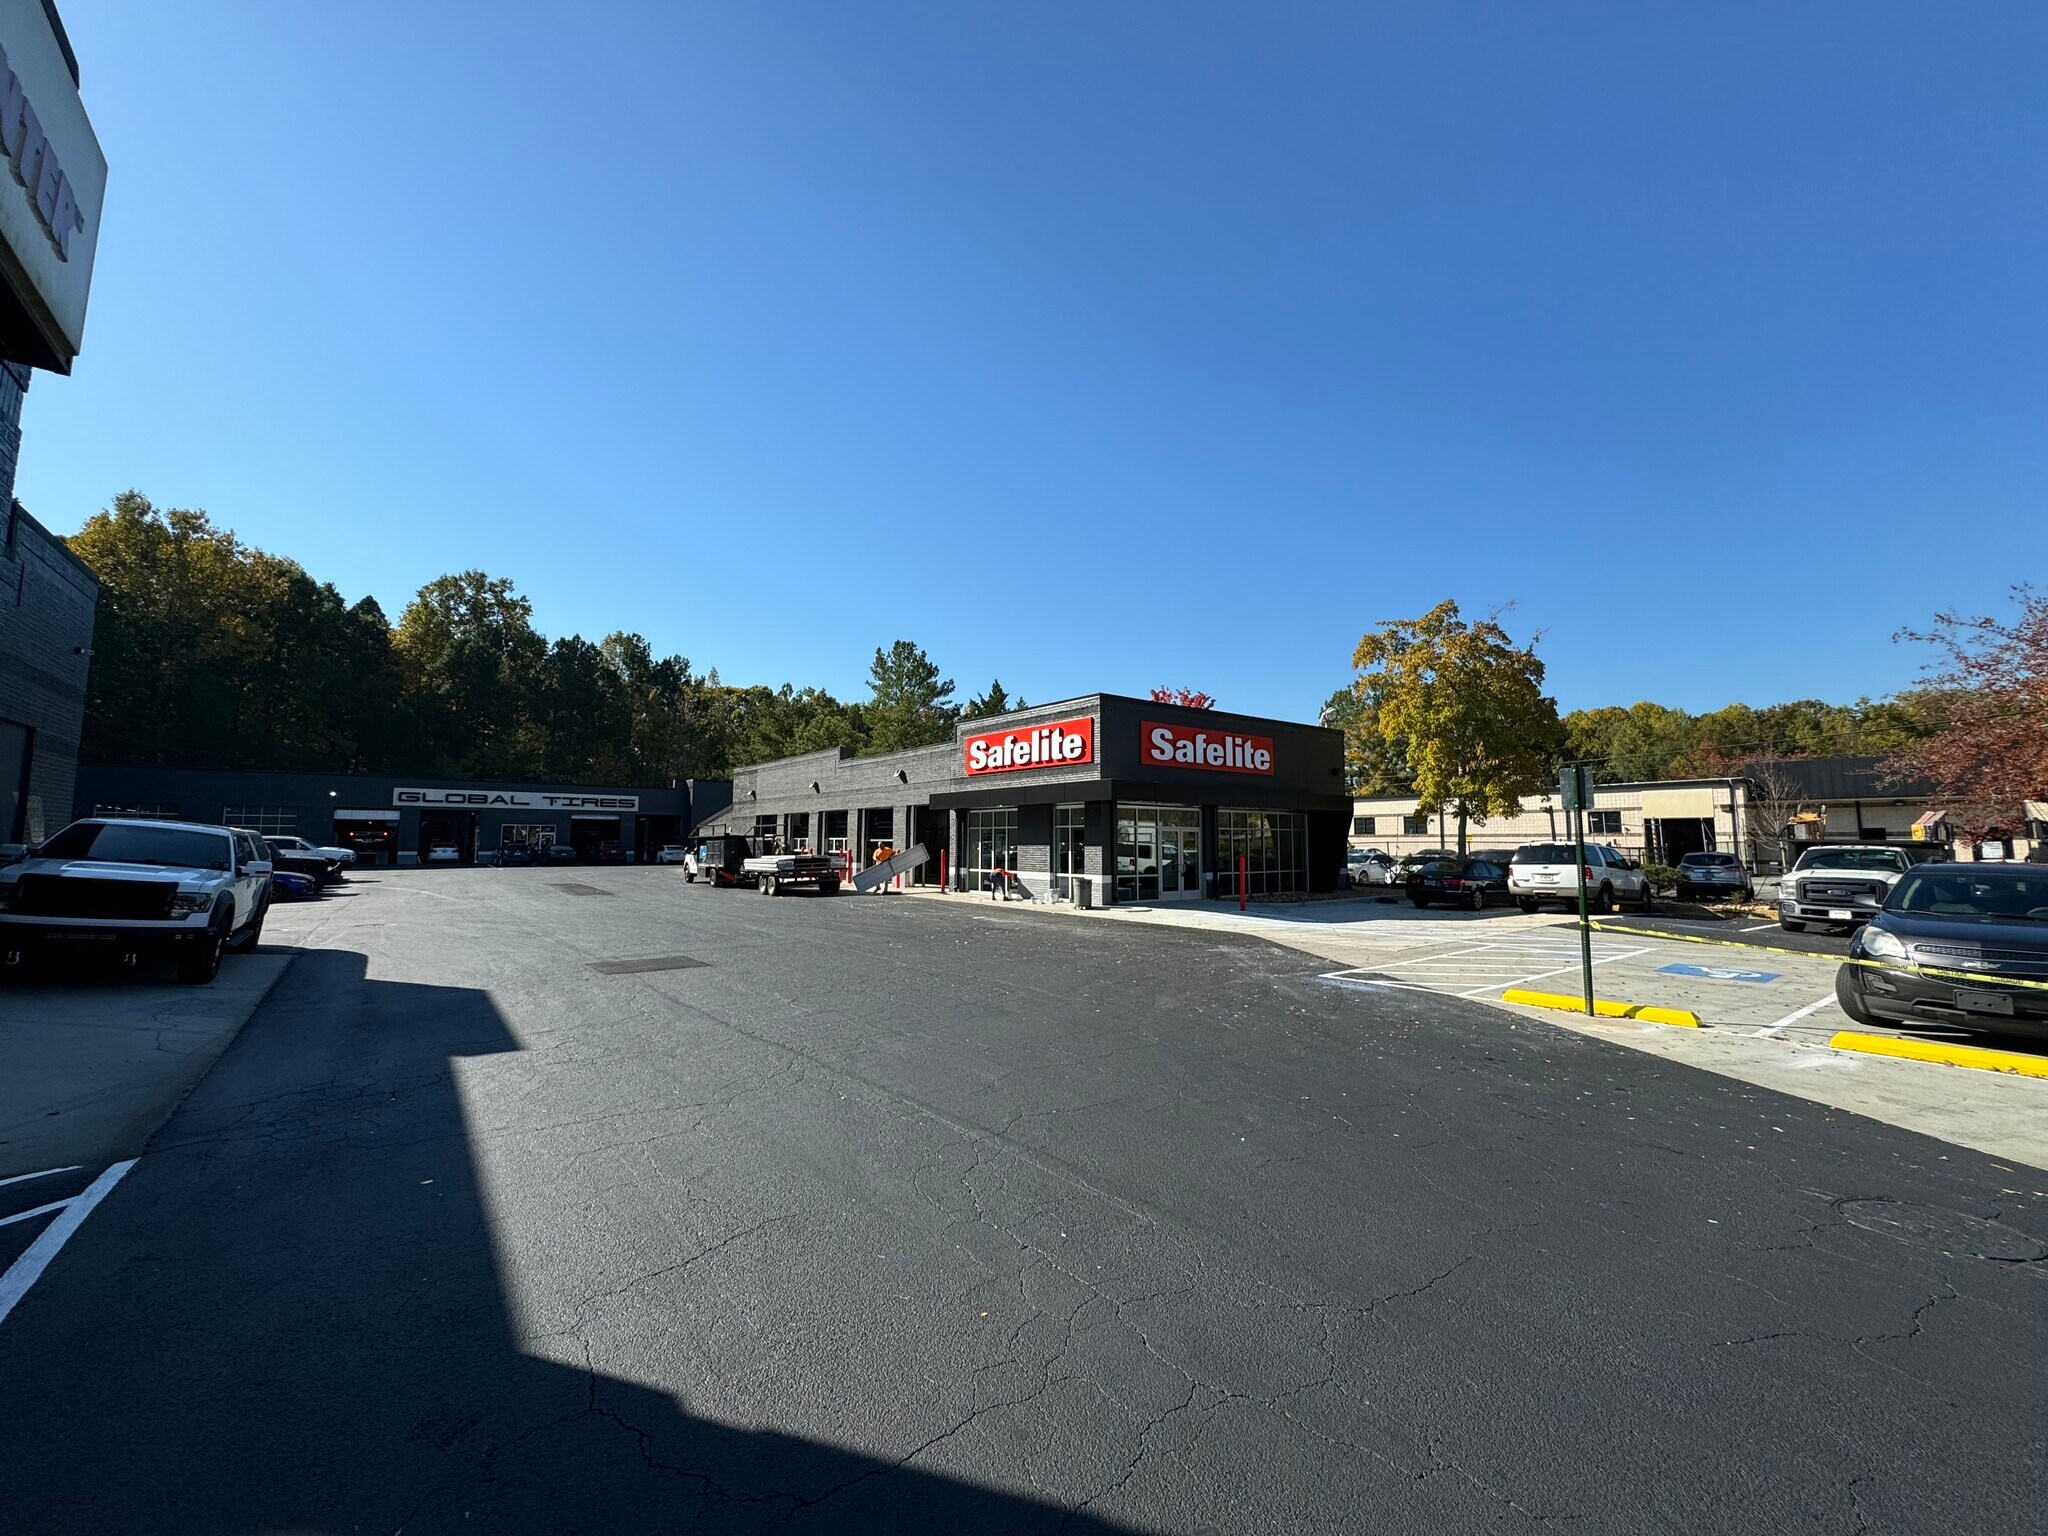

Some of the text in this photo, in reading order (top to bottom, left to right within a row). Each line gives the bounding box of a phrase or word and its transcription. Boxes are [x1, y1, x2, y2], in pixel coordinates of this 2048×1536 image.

[969, 729, 1083, 769] Safelite
[1151, 728, 1270, 770] Safelite
[398, 791, 636, 808] GLOBAL TIRES
